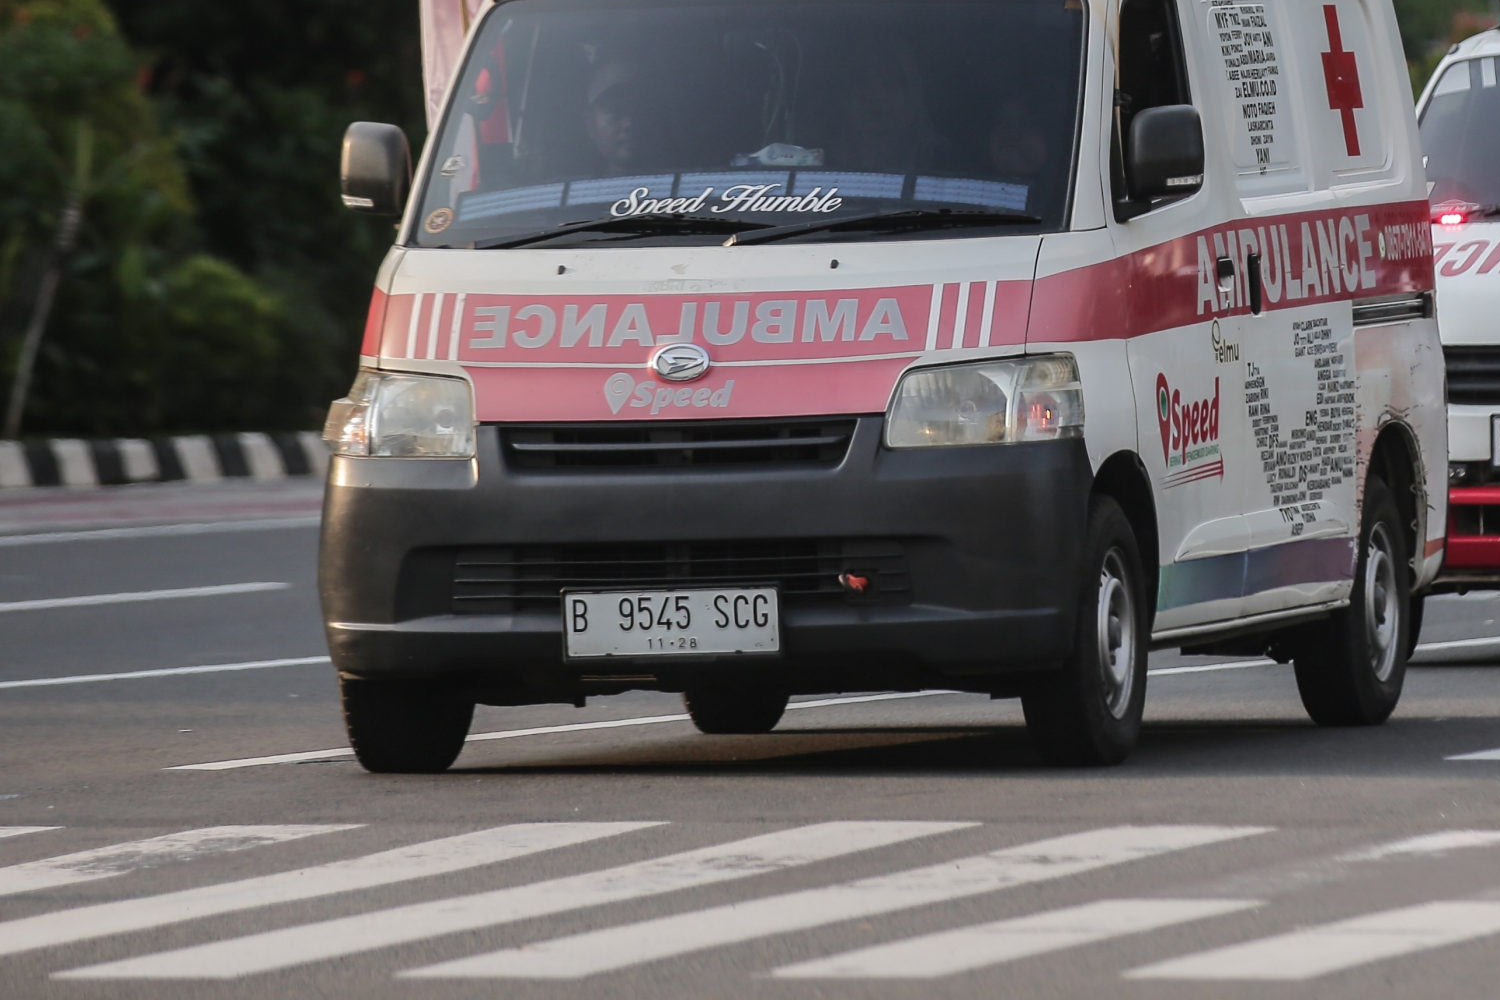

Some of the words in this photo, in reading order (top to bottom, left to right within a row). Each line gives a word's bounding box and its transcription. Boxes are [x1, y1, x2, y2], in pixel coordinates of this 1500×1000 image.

[1242, 80, 1277, 97] ELMU.CO.ID
[1242, 103, 1258, 119] NOTO
[1255, 148, 1270, 164] YANI
[610, 187, 712, 217] Speed
[711, 183, 843, 214] Humble
[1196, 213, 1377, 315] AMBULANCE
[1219, 340, 1239, 363] elmu
[630, 380, 735, 416] Speed
[1171, 376, 1220, 466] Speed
[572, 599, 588, 633] B
[618, 596, 692, 632] 9545
[713, 594, 769, 629] SCG
